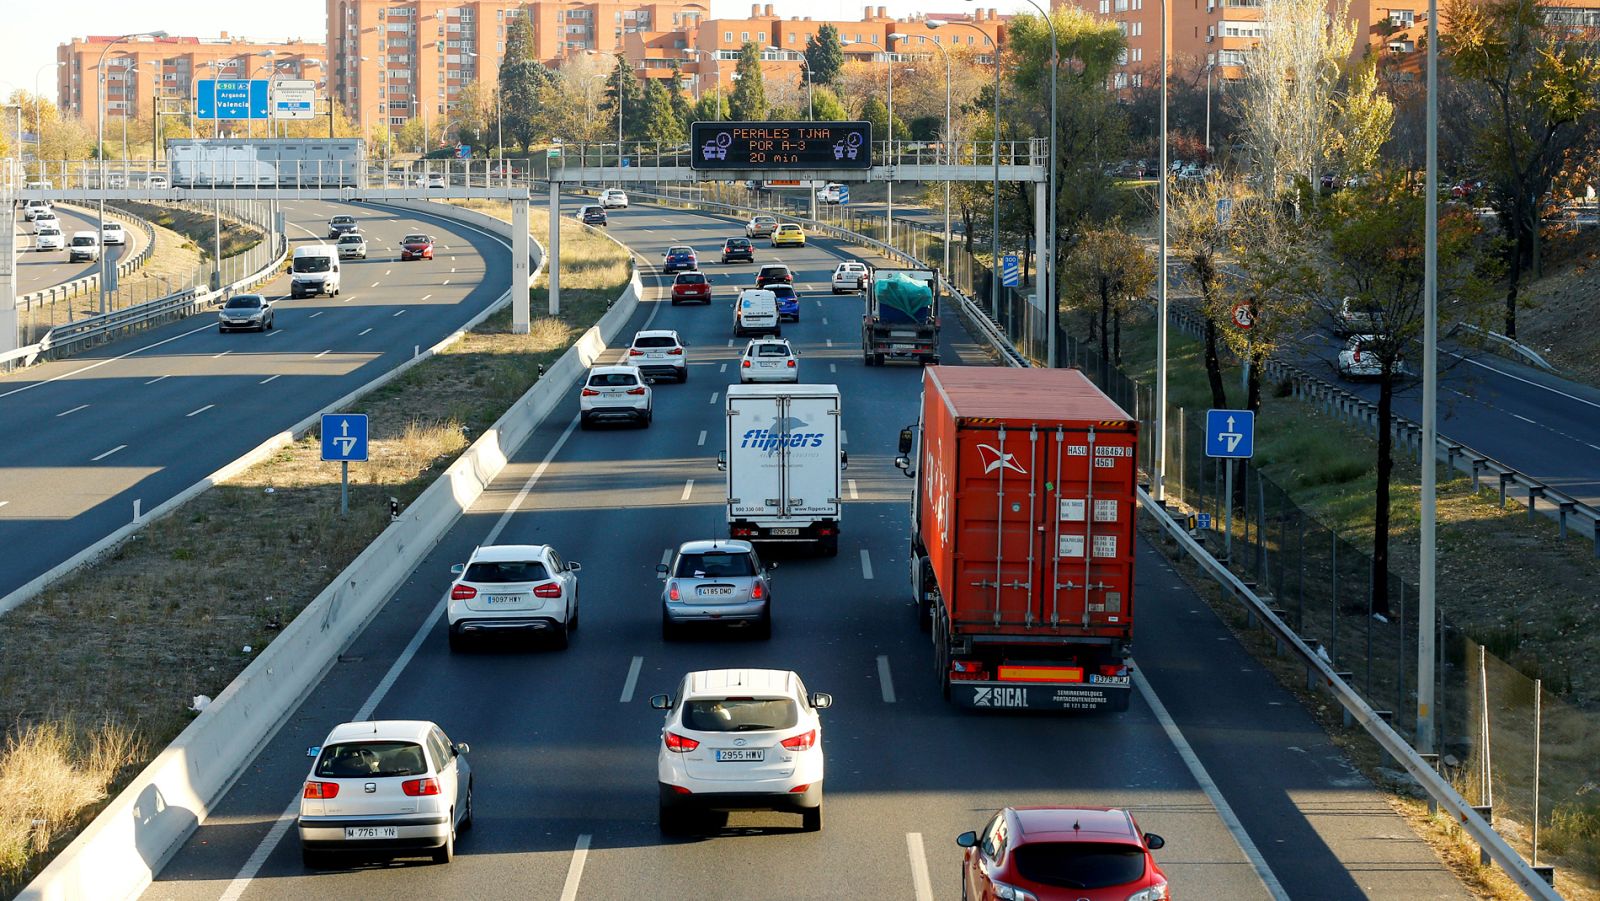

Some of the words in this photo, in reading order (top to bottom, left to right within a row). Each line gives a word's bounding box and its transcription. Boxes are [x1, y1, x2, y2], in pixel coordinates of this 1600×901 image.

[733, 128, 790, 139] PERALES
[749, 140, 773, 151] POR
[781, 140, 806, 151] A-3
[749, 153, 766, 163] 20
[773, 154, 798, 163] min
[740, 429, 825, 452] flippers
[1067, 446, 1086, 455] HASU
[1096, 446, 1123, 456] 486462
[993, 687, 1029, 707] SICAL
[721, 751, 744, 759] 2955
[358, 828, 378, 837] 7761
